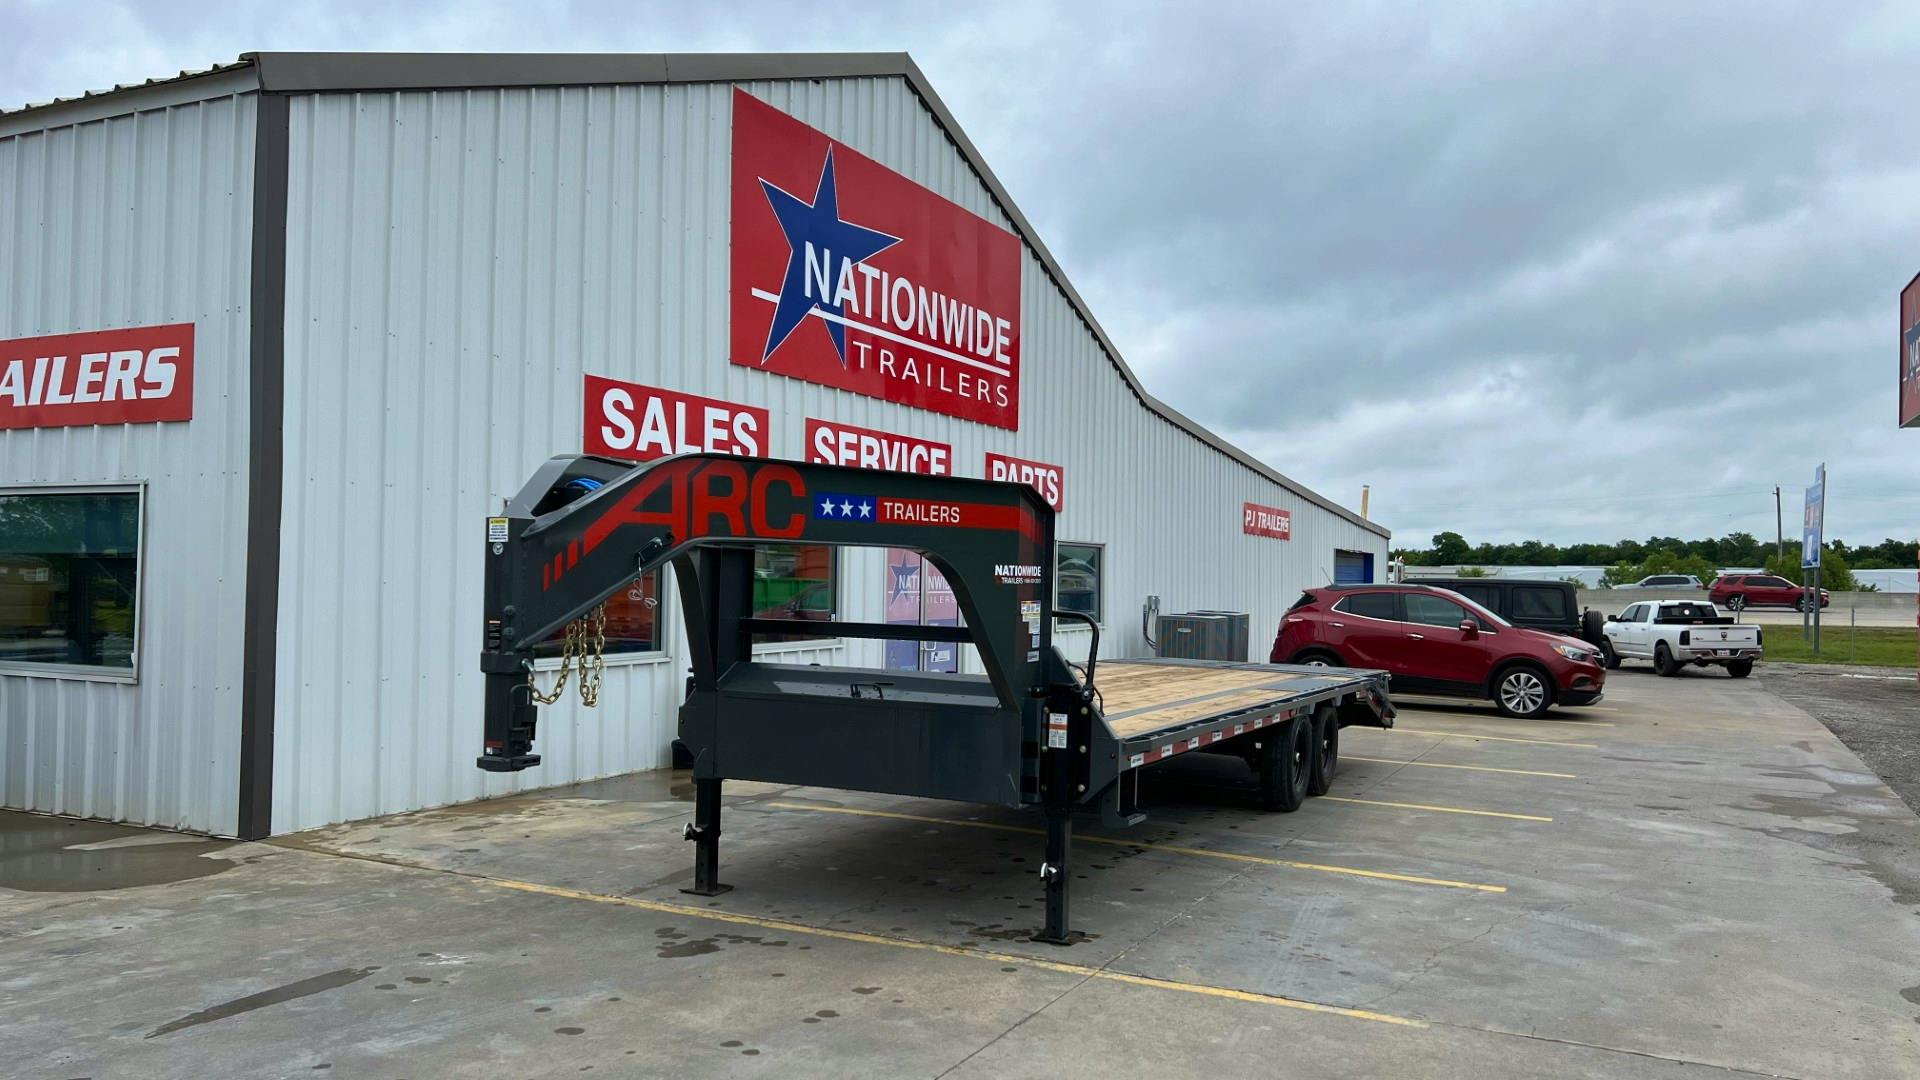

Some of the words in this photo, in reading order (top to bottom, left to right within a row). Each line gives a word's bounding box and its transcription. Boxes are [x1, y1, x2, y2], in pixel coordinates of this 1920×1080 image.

[804, 240, 1011, 366] NATIONWIDE
[852, 340, 1010, 408] TRAILERS
[601, 387, 758, 458] SALES
[813, 426, 946, 476] SERVICE
[583, 457, 806, 553] ARC
[883, 501, 961, 524] TRAILERS
[1245, 509, 1256, 527] PJ
[1257, 511, 1289, 533] TRAILERS
[994, 564, 1042, 577] NATIONWIDE
